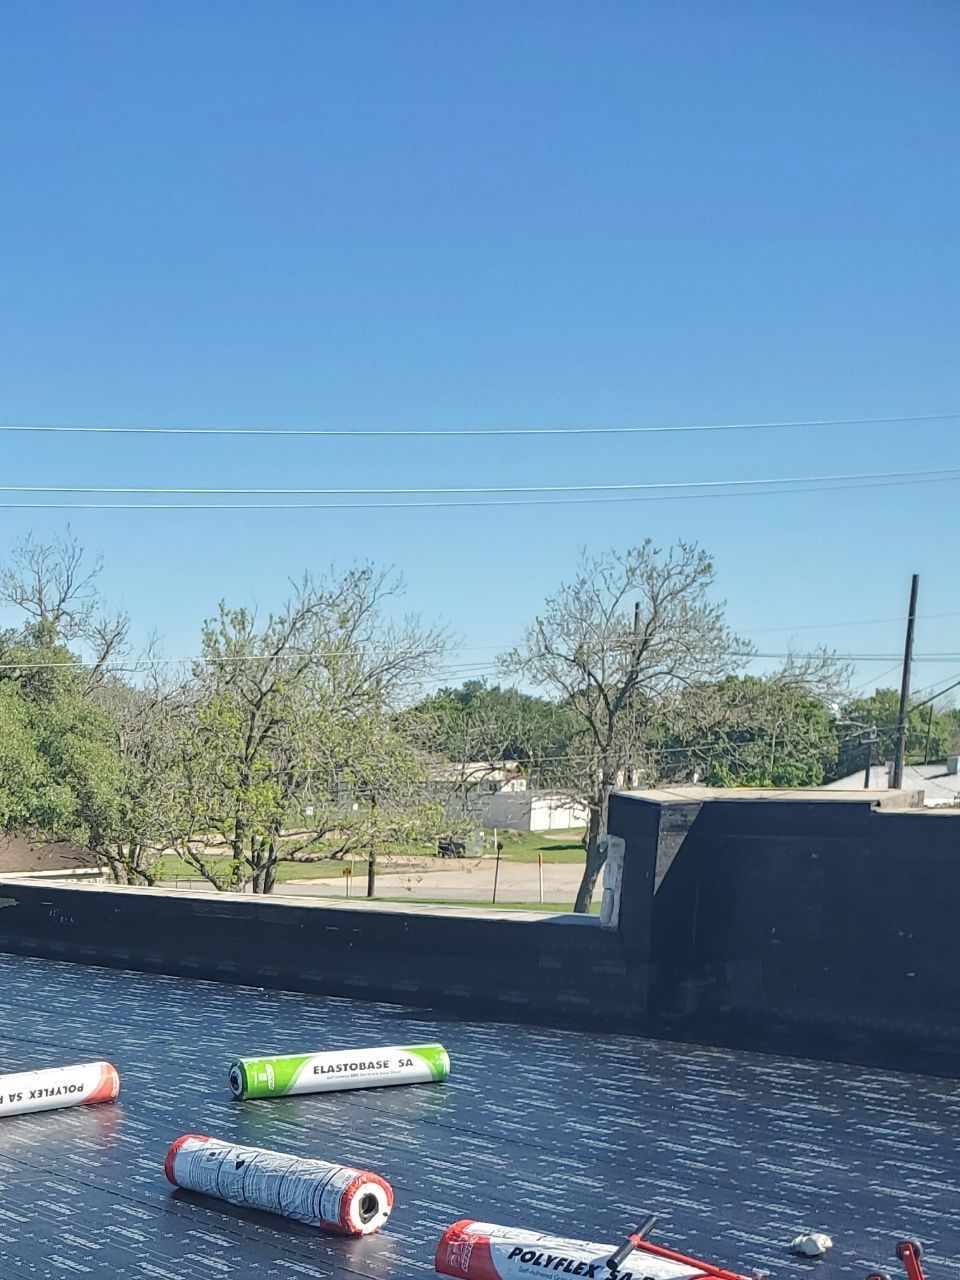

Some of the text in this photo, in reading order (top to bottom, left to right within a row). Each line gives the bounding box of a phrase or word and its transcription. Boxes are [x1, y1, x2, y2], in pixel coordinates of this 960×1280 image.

[312, 1058, 414, 1075] ELASTOBASE SA
[8, 1092, 23, 1103] SA
[29, 1083, 85, 1100] POLYFLEX
[507, 1247, 602, 1279] POLYFLEX
